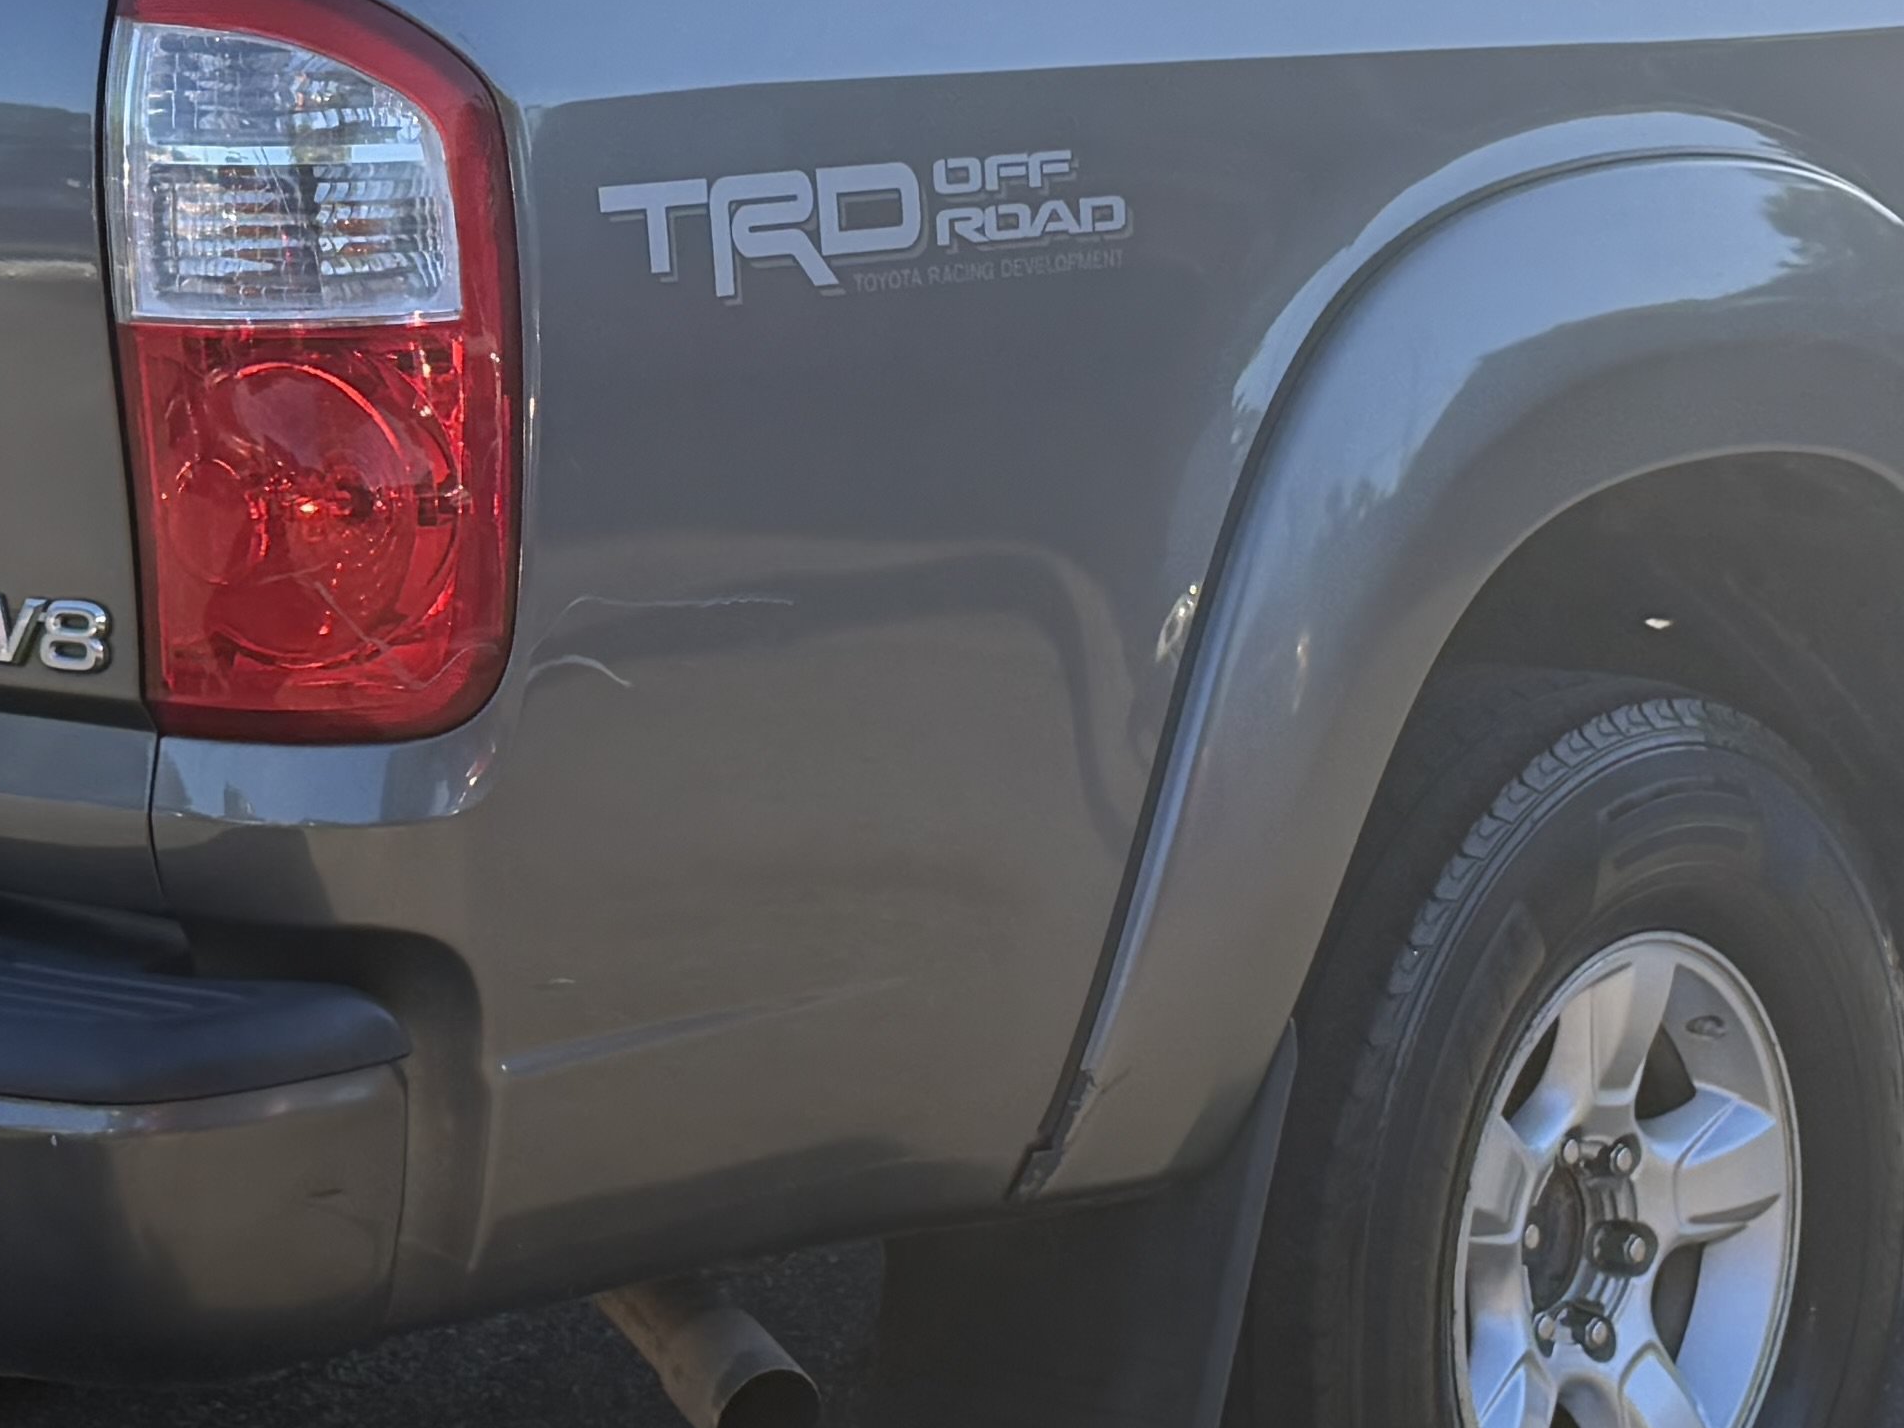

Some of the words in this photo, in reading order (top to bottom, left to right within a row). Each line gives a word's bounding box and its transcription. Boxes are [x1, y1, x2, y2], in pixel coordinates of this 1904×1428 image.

[933, 149, 1072, 196] OFF
[598, 161, 922, 298] TRD
[936, 195, 1126, 246] ROAD
[853, 271, 923, 293] TOYOTA
[928, 262, 996, 285] RACING
[1000, 249, 1124, 279] DEVELOPMENT
